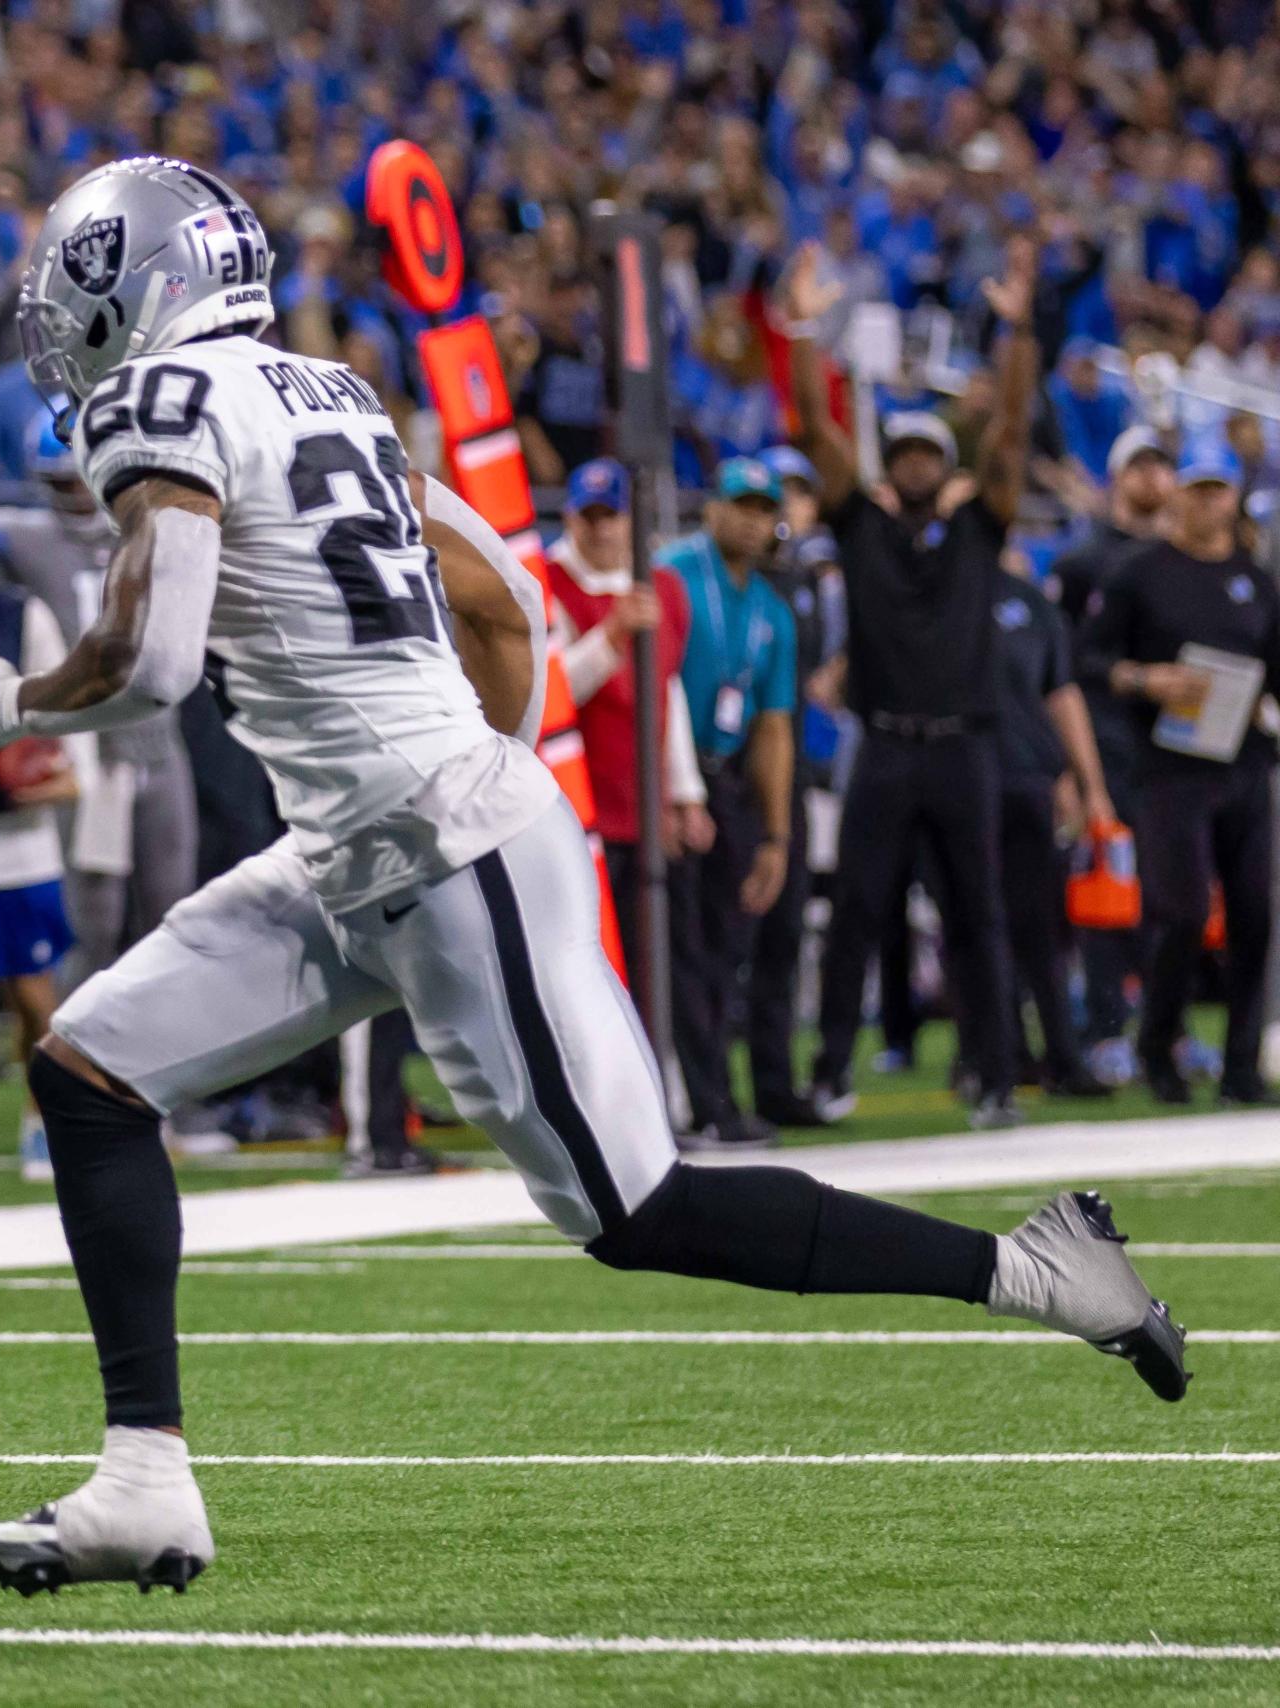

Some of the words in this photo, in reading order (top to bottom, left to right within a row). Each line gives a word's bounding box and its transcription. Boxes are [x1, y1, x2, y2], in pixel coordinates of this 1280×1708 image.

[220, 247, 267, 285] 20
[225, 289, 267, 308] RAIDERS
[82, 362, 211, 452] 20
[286, 430, 457, 648] 20
